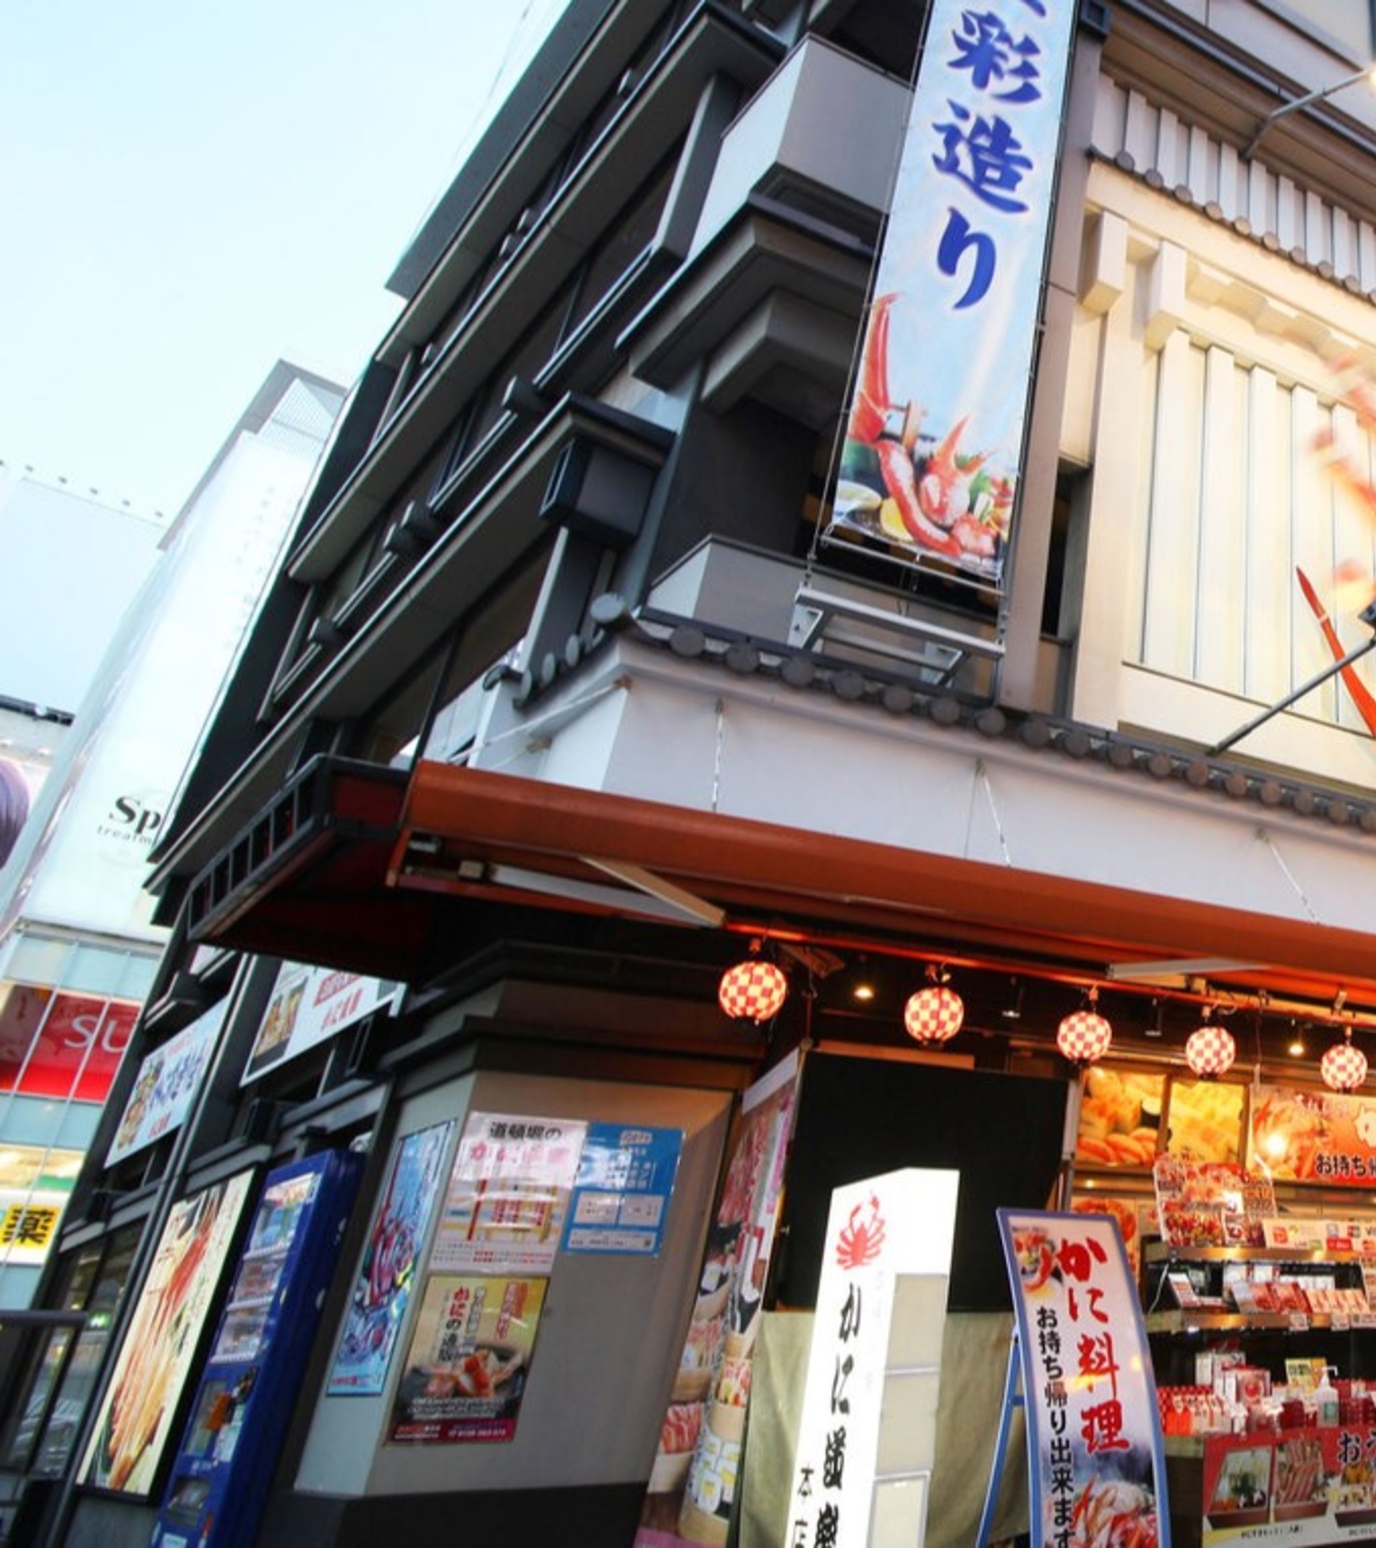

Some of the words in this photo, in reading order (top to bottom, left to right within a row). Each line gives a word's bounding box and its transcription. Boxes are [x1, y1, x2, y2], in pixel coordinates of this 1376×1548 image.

[931, 0, 1047, 311] 彩造り
[3, 1208, 55, 1246] 薬
[1057, 1237, 1130, 1454] かに料理
